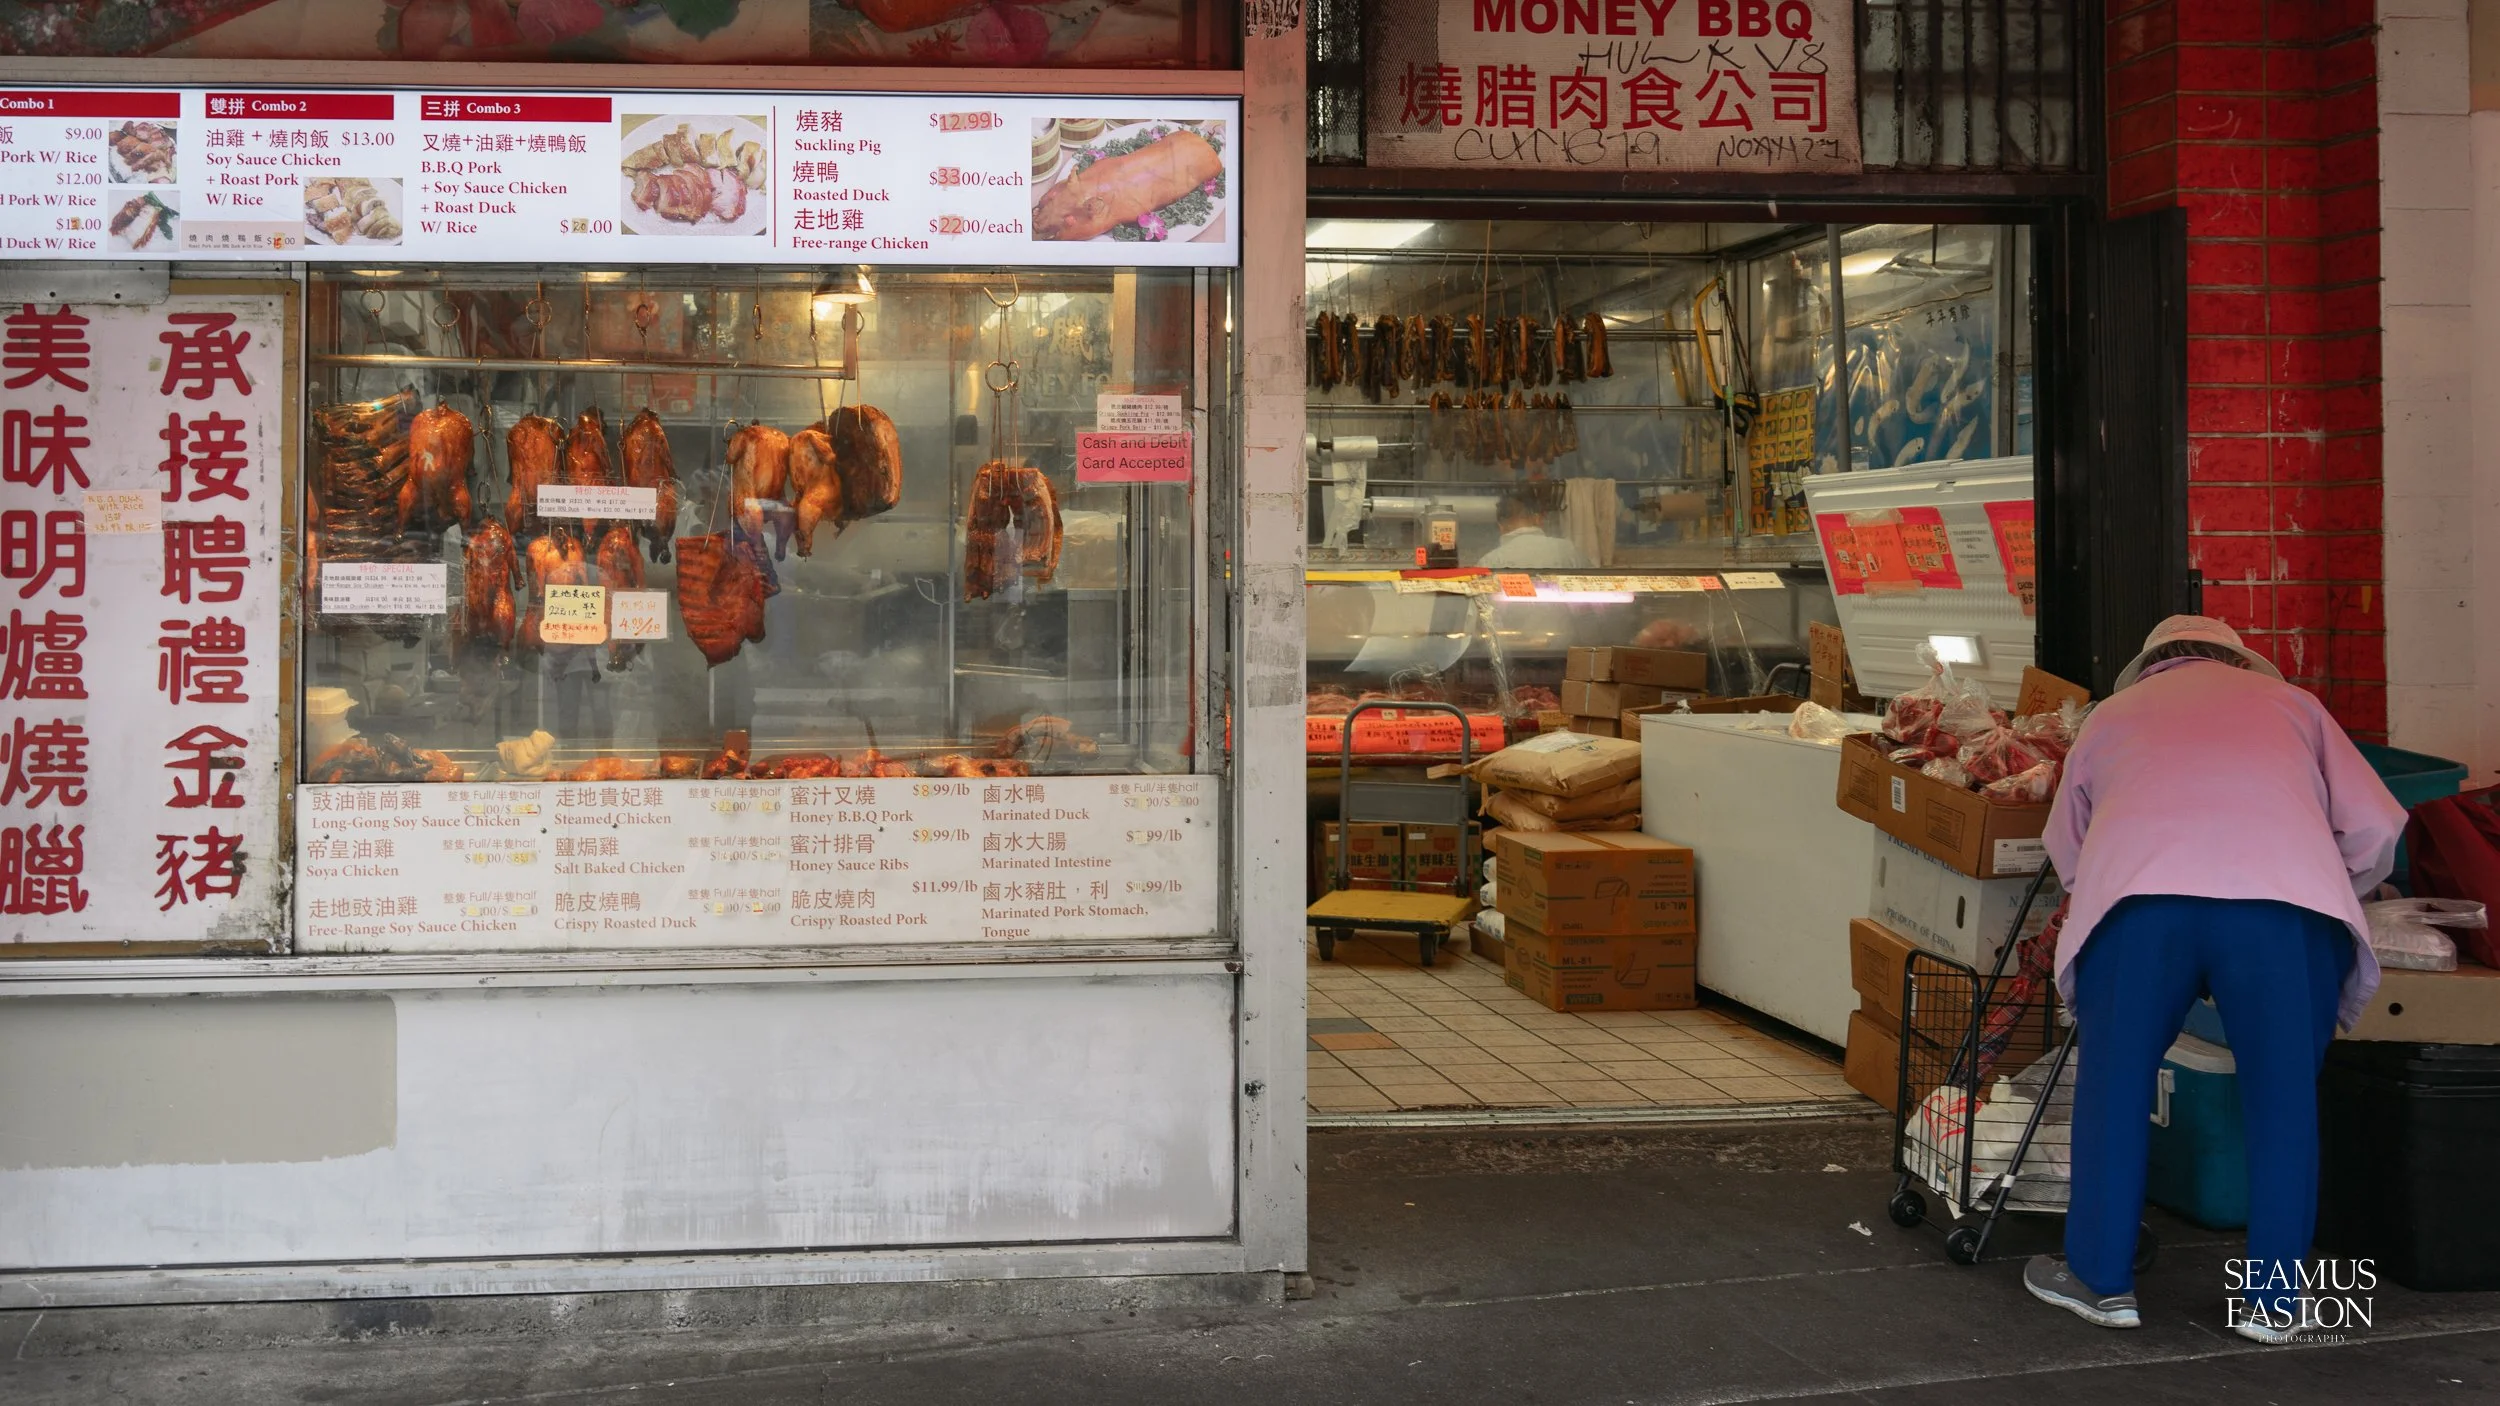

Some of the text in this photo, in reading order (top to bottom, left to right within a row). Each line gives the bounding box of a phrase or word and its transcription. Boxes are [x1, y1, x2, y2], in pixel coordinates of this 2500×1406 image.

[1473, 0, 1814, 42] MONEY BBQ
[0, 98, 54, 109] Combo 1
[210, 98, 307, 115] 雙拼 Combo 2
[425, 101, 521, 116] 三拼 Combo 3
[795, 109, 843, 132] 燒豬
[65, 128, 102, 140] $9.00
[206, 128, 395, 148] 油雞 燒肉飯 $13.00
[795, 138, 881, 154] Suckling Pig
[1, 150, 97, 164] Pork W/ Rice
[206, 153, 341, 169] Soy Sauce Chicken
[421, 161, 501, 176] B.B.Q Pork
[792, 160, 839, 183] 燒鴨
[56, 172, 102, 185] $12.00
[220, 172, 299, 185] Roast Pork
[434, 181, 567, 197] Soy Sauce Chicken
[793, 188, 889, 201] Roasted Duck
[9, 194, 96, 207] Pork W/ Rice
[206, 193, 263, 207] W/ Rice
[434, 201, 516, 214] Roast Duck
[793, 208, 864, 231] 走地雞
[420, 221, 442, 234] W/
[447, 221, 477, 233] Rice
[7, 237, 96, 250] Duck W/ Rice
[792, 236, 928, 251] Free-range Chicken
[1083, 437, 1187, 449] Cash and Debit
[1082, 456, 1185, 471] Card Accepted
[791, 783, 970, 805] 蜜汁叉燒 $8.99/lb
[554, 812, 672, 825] Steamed Chicken
[790, 810, 913, 825] Honey B.B.Q Pork
[982, 808, 1089, 821] Marinated Duck
[312, 814, 520, 831] Long-Gong Soy Sauce Chicken
[307, 838, 395, 860] 帝皇油雞
[791, 829, 970, 854] 蜜汁排骨 $9.99/lb
[554, 861, 685, 874] Salt Baked Chicken
[790, 859, 909, 874] Honey Sauce Ribs
[982, 856, 1111, 869] Marinated Intestine
[1347, 854, 1389, 867] 味生抽
[1419, 853, 1470, 867] 鮮味生
[306, 864, 399, 879] Soya Chicken
[791, 888, 875, 909] 脆皮燒肉
[912, 880, 978, 894] $11.99/lb
[982, 907, 1049, 920] Marinated
[1054, 905, 1084, 917] Pork
[554, 916, 697, 932] Crispy Roasted Duck
[791, 913, 928, 929] Crispy Roasted Pork
[308, 920, 517, 938] Free-Range Soy Sauce Chicken
[982, 926, 1030, 941] Tongue
